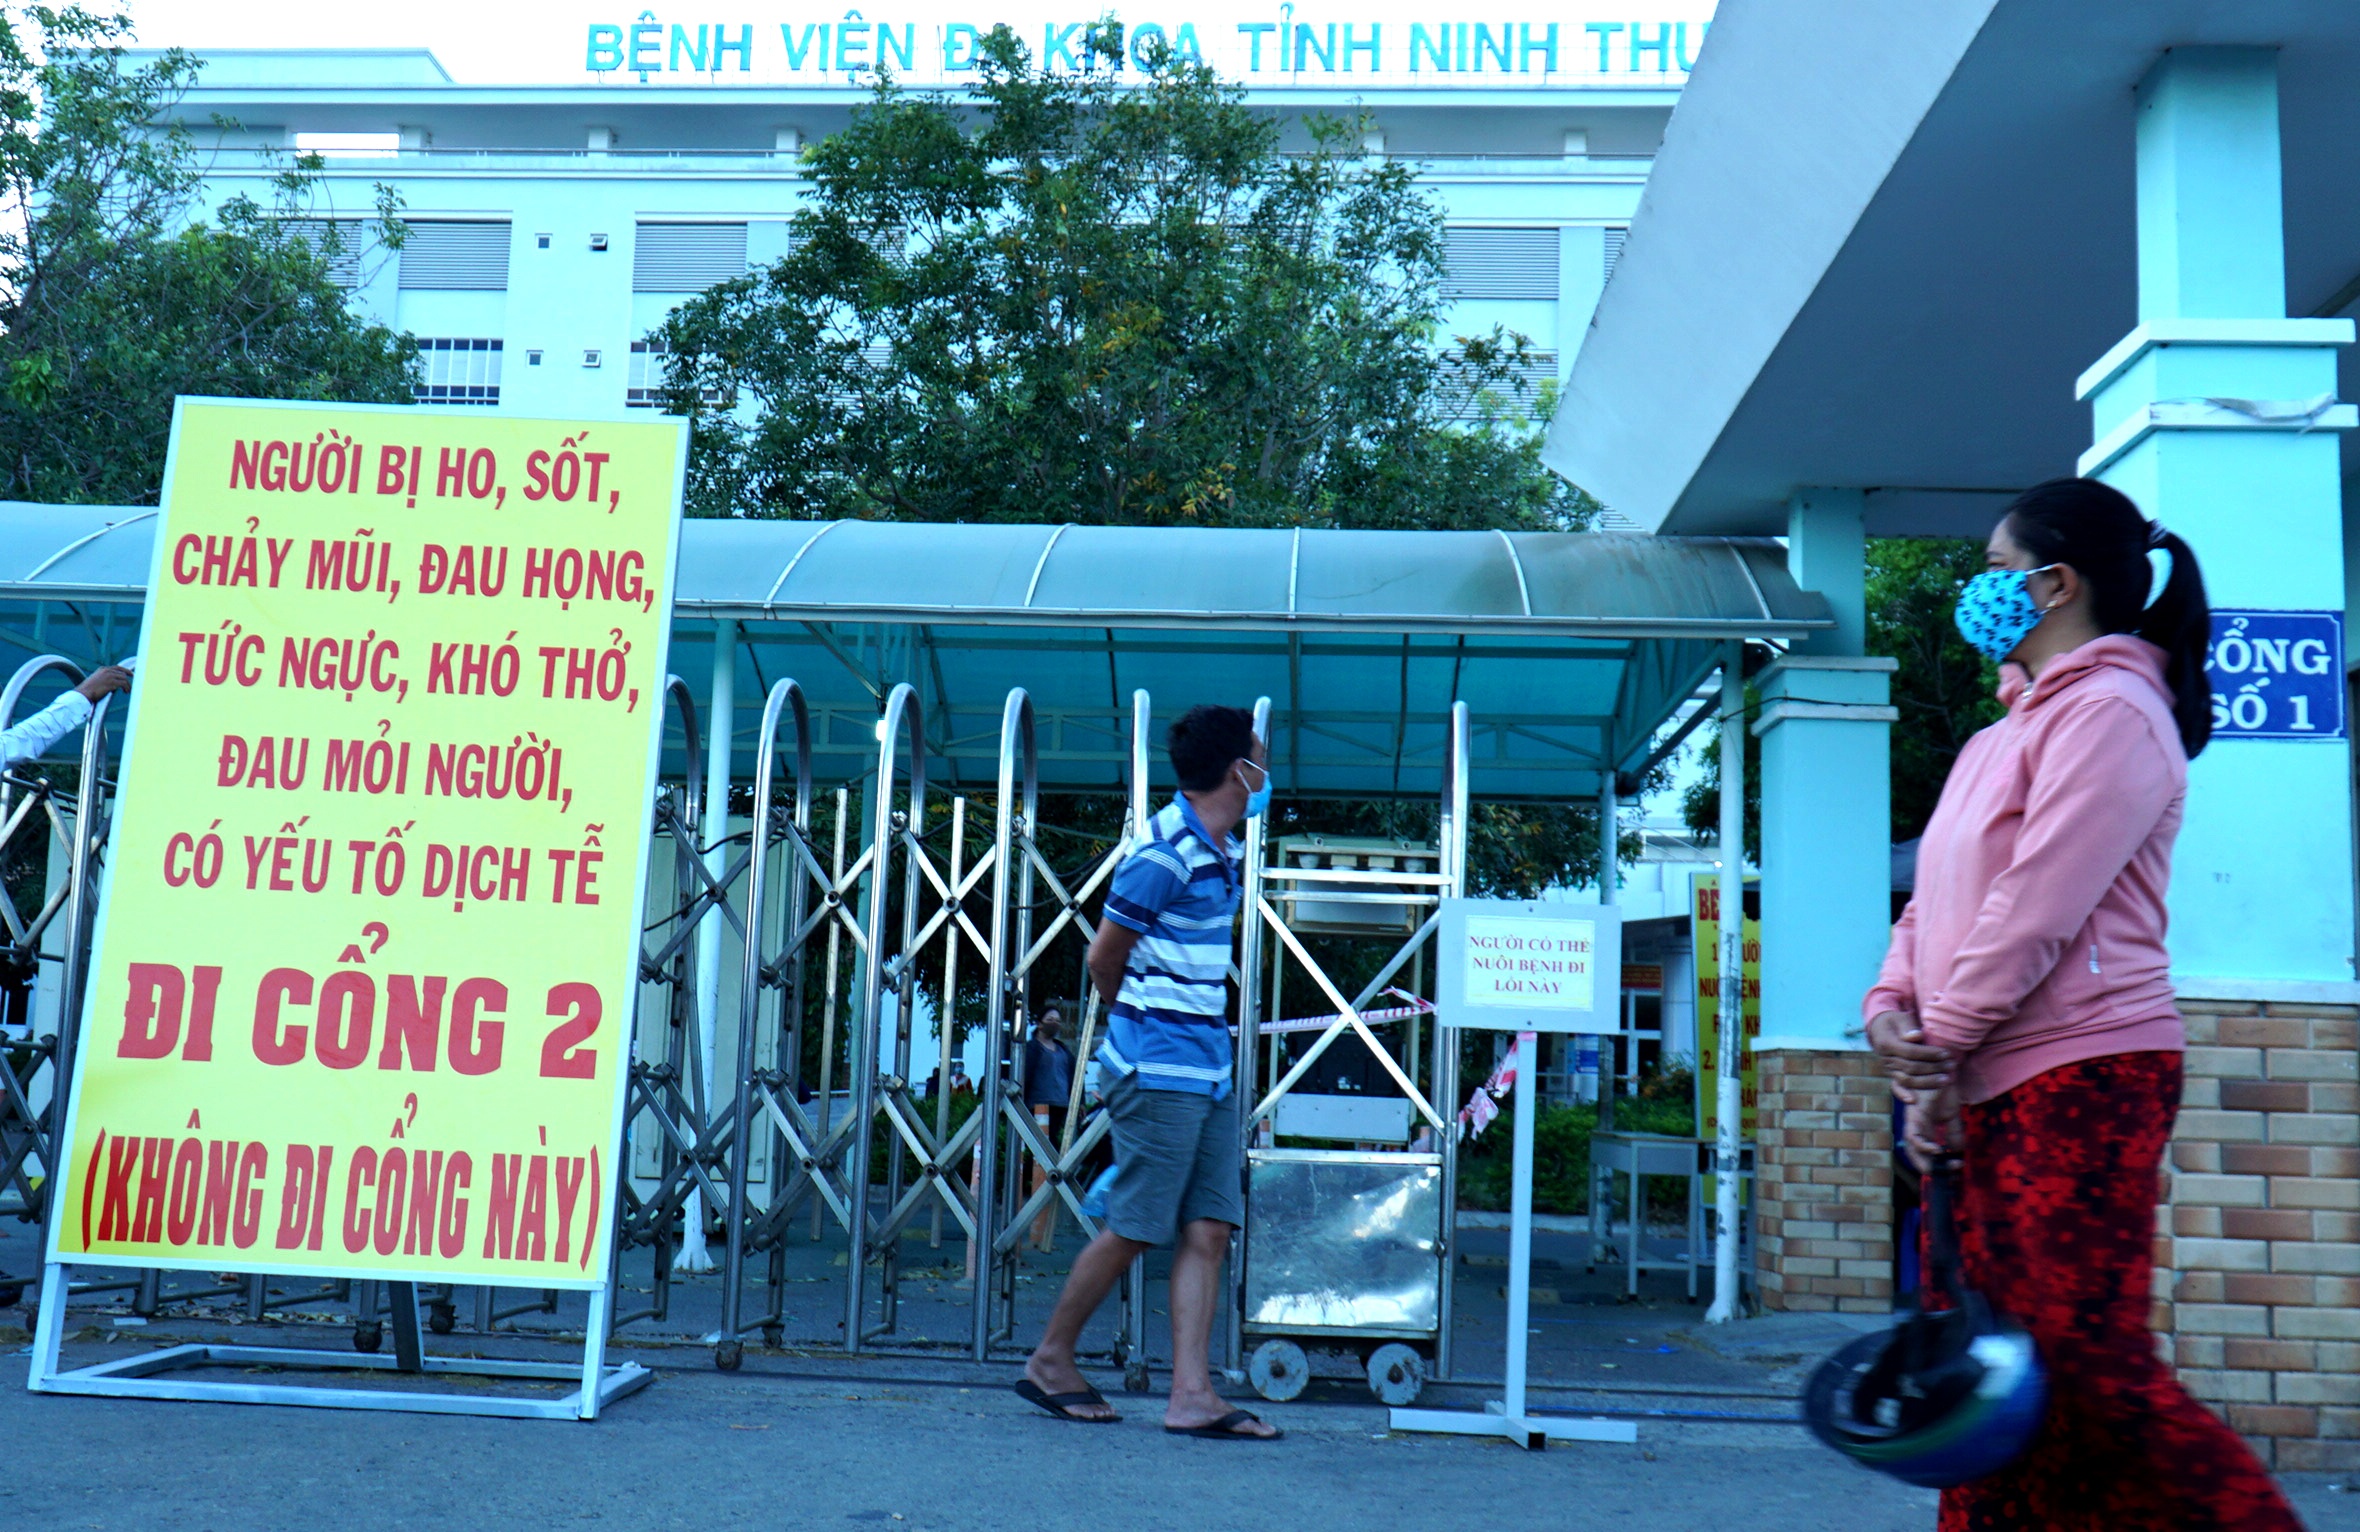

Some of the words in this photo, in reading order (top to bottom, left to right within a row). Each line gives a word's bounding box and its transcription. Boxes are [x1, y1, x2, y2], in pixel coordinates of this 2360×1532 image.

[586, 9, 753, 83] BỆNH
[780, 9, 914, 83] VIỆN
[943, 22, 1010, 72] Đ
[1238, 1, 1381, 72] TỈNH
[1410, 22, 1558, 72] NINH
[230, 429, 361, 493] NGƯỜI
[377, 446, 421, 508] BỊ
[437, 448, 506, 509] HO,
[523, 431, 620, 512] SỐT,
[173, 517, 292, 588] CHẢY
[306, 529, 400, 603] MŨI,
[419, 544, 507, 596] ĐAU
[523, 548, 654, 612] HỌNG,
[179, 620, 264, 686] TỨC
[279, 631, 408, 703] NGỰC,
[428, 631, 519, 697] KHÓ
[539, 628, 639, 712] THỞ,
[2203, 617, 2332, 675] ỔNG
[2211, 677, 2270, 730] SỐ
[2289, 695, 2315, 730] 1
[218, 736, 308, 790] ĐAU
[324, 720, 410, 794] MỎI
[425, 732, 572, 812] NGƯỜI,
[164, 820, 223, 887] CÓ
[245, 816, 331, 892] YẾU
[349, 821, 414, 896] TỐ
[423, 844, 530, 912] DỊCH
[549, 823, 604, 904] TỄ
[1470, 934, 1524, 950] NGƯỜI
[1529, 936, 1552, 951] CÓ
[1473, 955, 1513, 970] NUÔI
[1519, 958, 1563, 975] BỆNH
[1568, 961, 1585, 974] ĐI
[118, 964, 222, 1062] ĐI
[253, 922, 508, 1076] CỔNG
[540, 983, 603, 1079] 2
[1528, 977, 1562, 993] NÀY
[82, 1110, 266, 1252] (KHÔNG
[276, 1145, 333, 1251] ĐI
[344, 1094, 472, 1259] CỔNG
[484, 1126, 600, 1271] NÀY)
